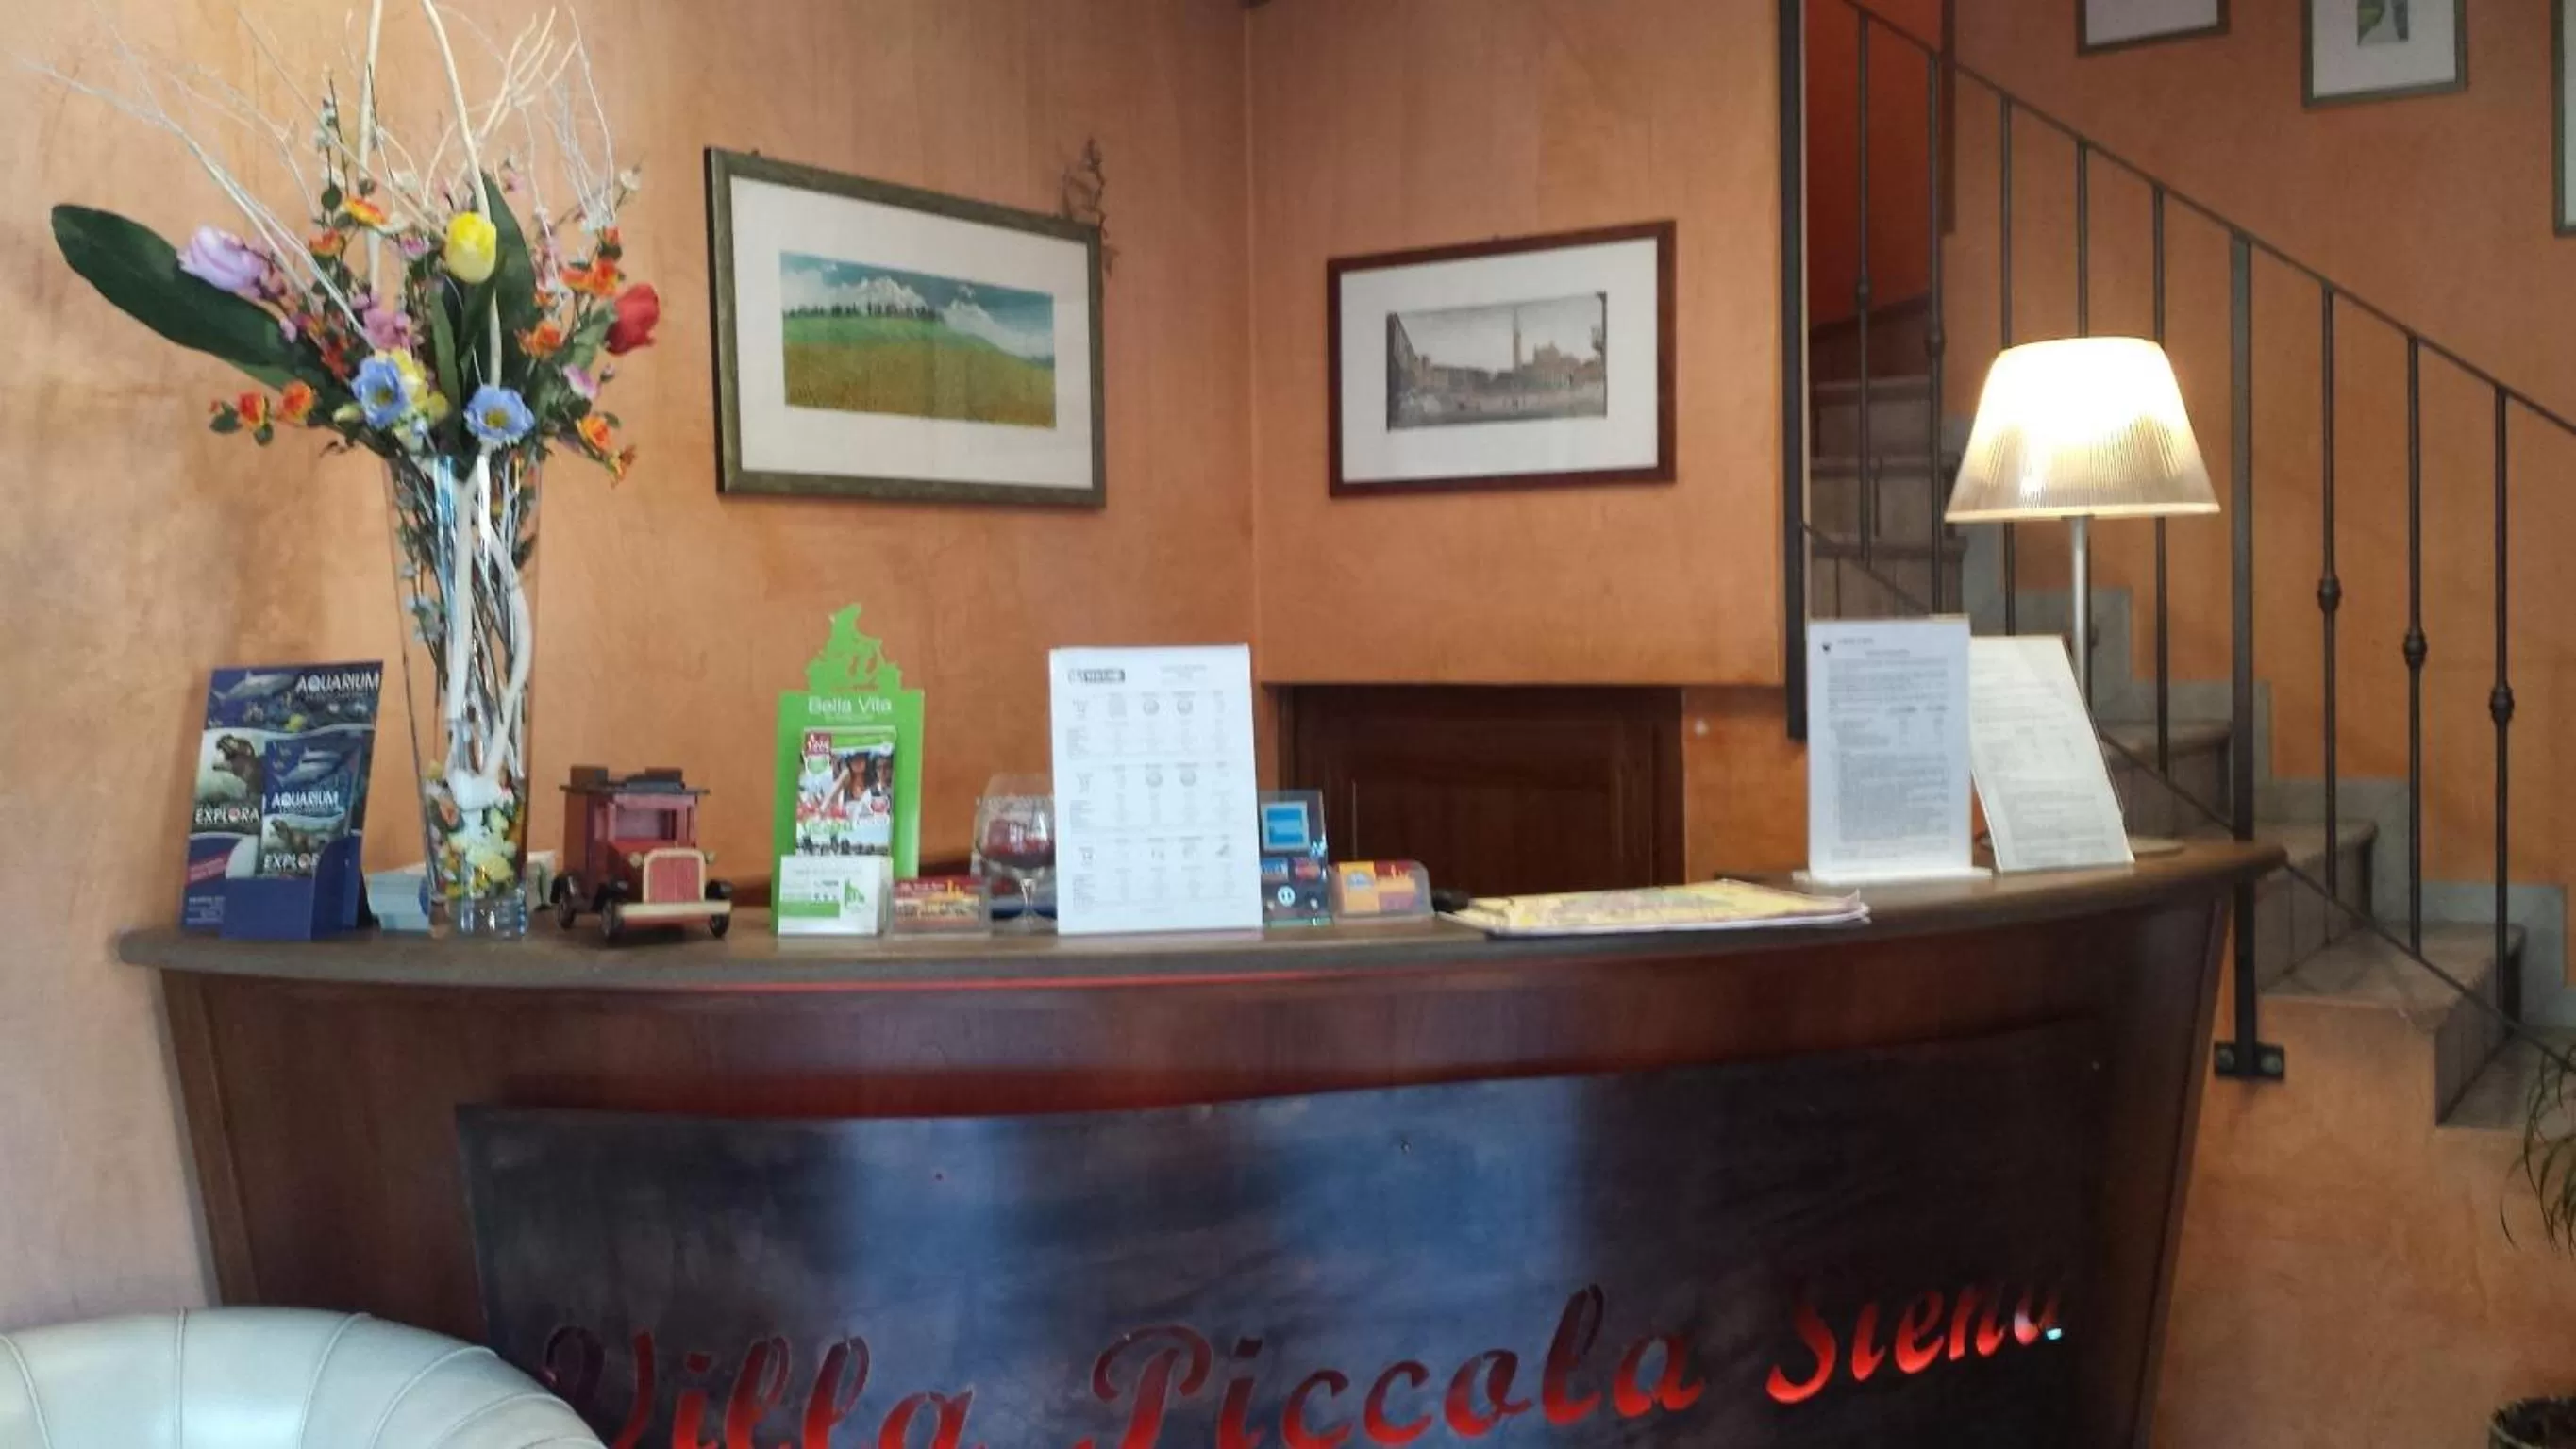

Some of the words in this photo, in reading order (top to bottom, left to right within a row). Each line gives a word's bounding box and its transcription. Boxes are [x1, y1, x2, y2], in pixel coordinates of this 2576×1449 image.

[295, 672, 379, 693] AQUARIUM
[809, 697, 852, 715] Bella
[858, 696, 893, 714] Vita
[271, 791, 340, 808] AQUARIUM
[194, 808, 260, 824] EXPLORA
[1074, 1283, 1704, 1449] Piccola
